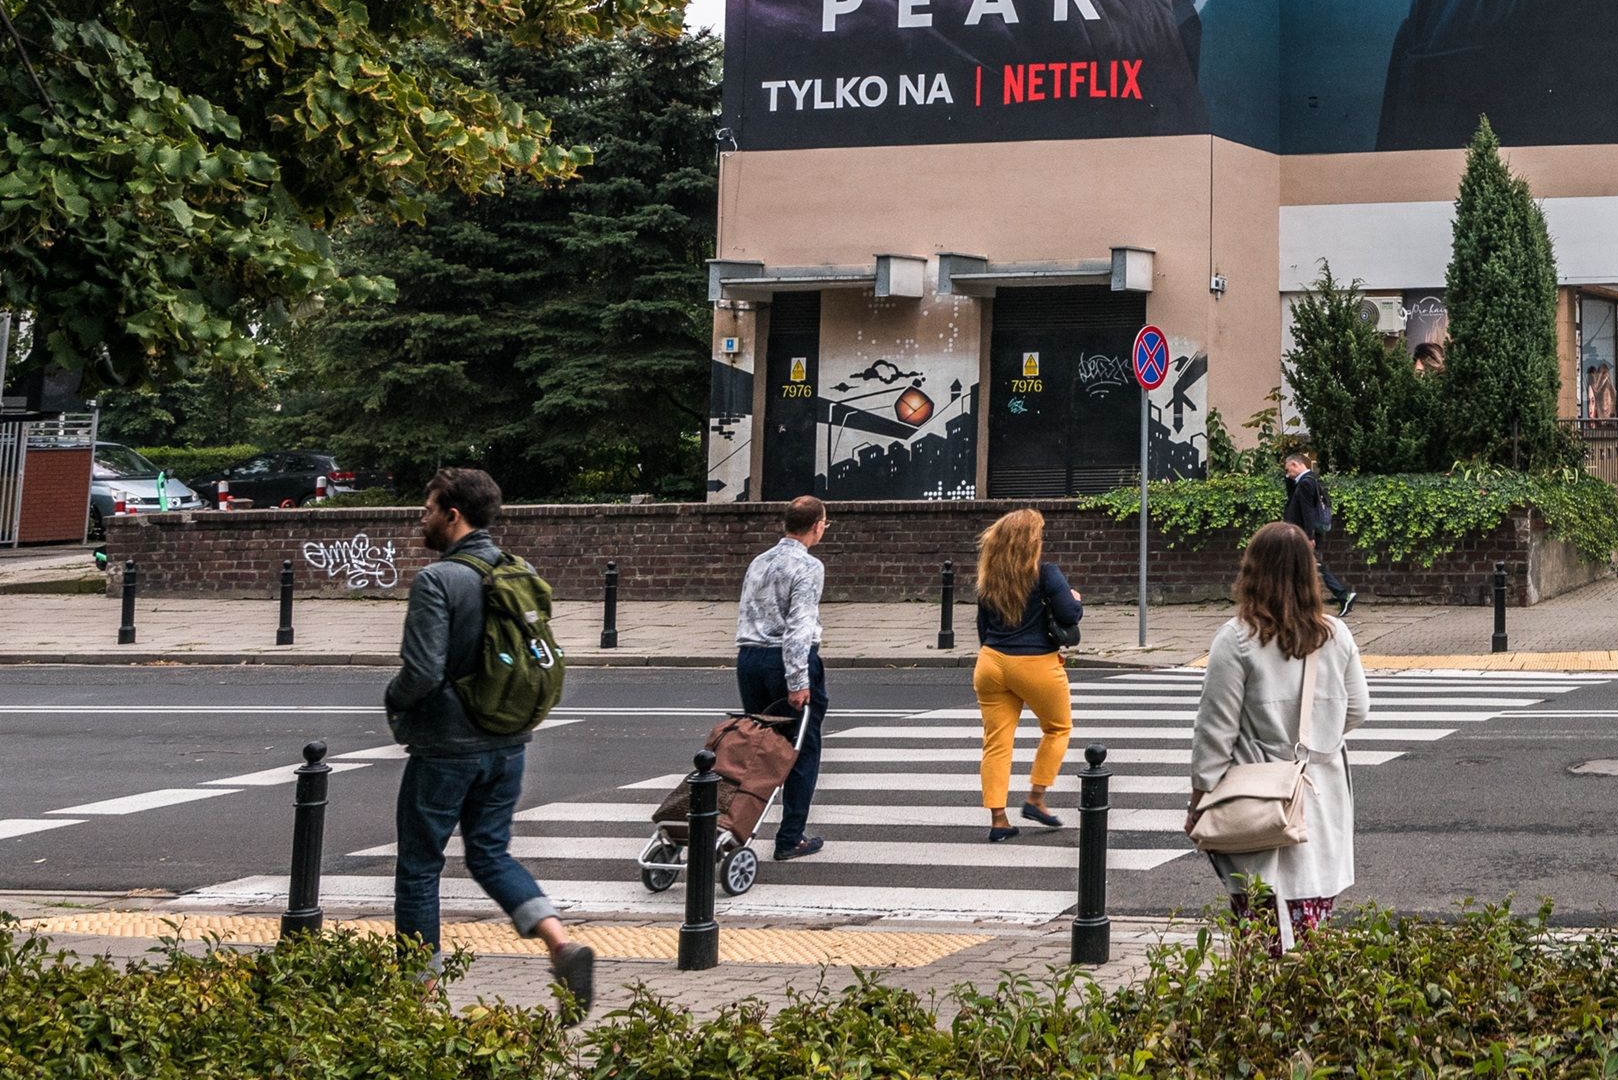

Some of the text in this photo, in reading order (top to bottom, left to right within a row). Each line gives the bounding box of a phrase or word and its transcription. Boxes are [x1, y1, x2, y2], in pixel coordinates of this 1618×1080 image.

[762, 59, 1143, 112] TYLKO NA NETFLIX
[782, 385, 812, 398] 7976
[1011, 379, 1043, 393] 7976
